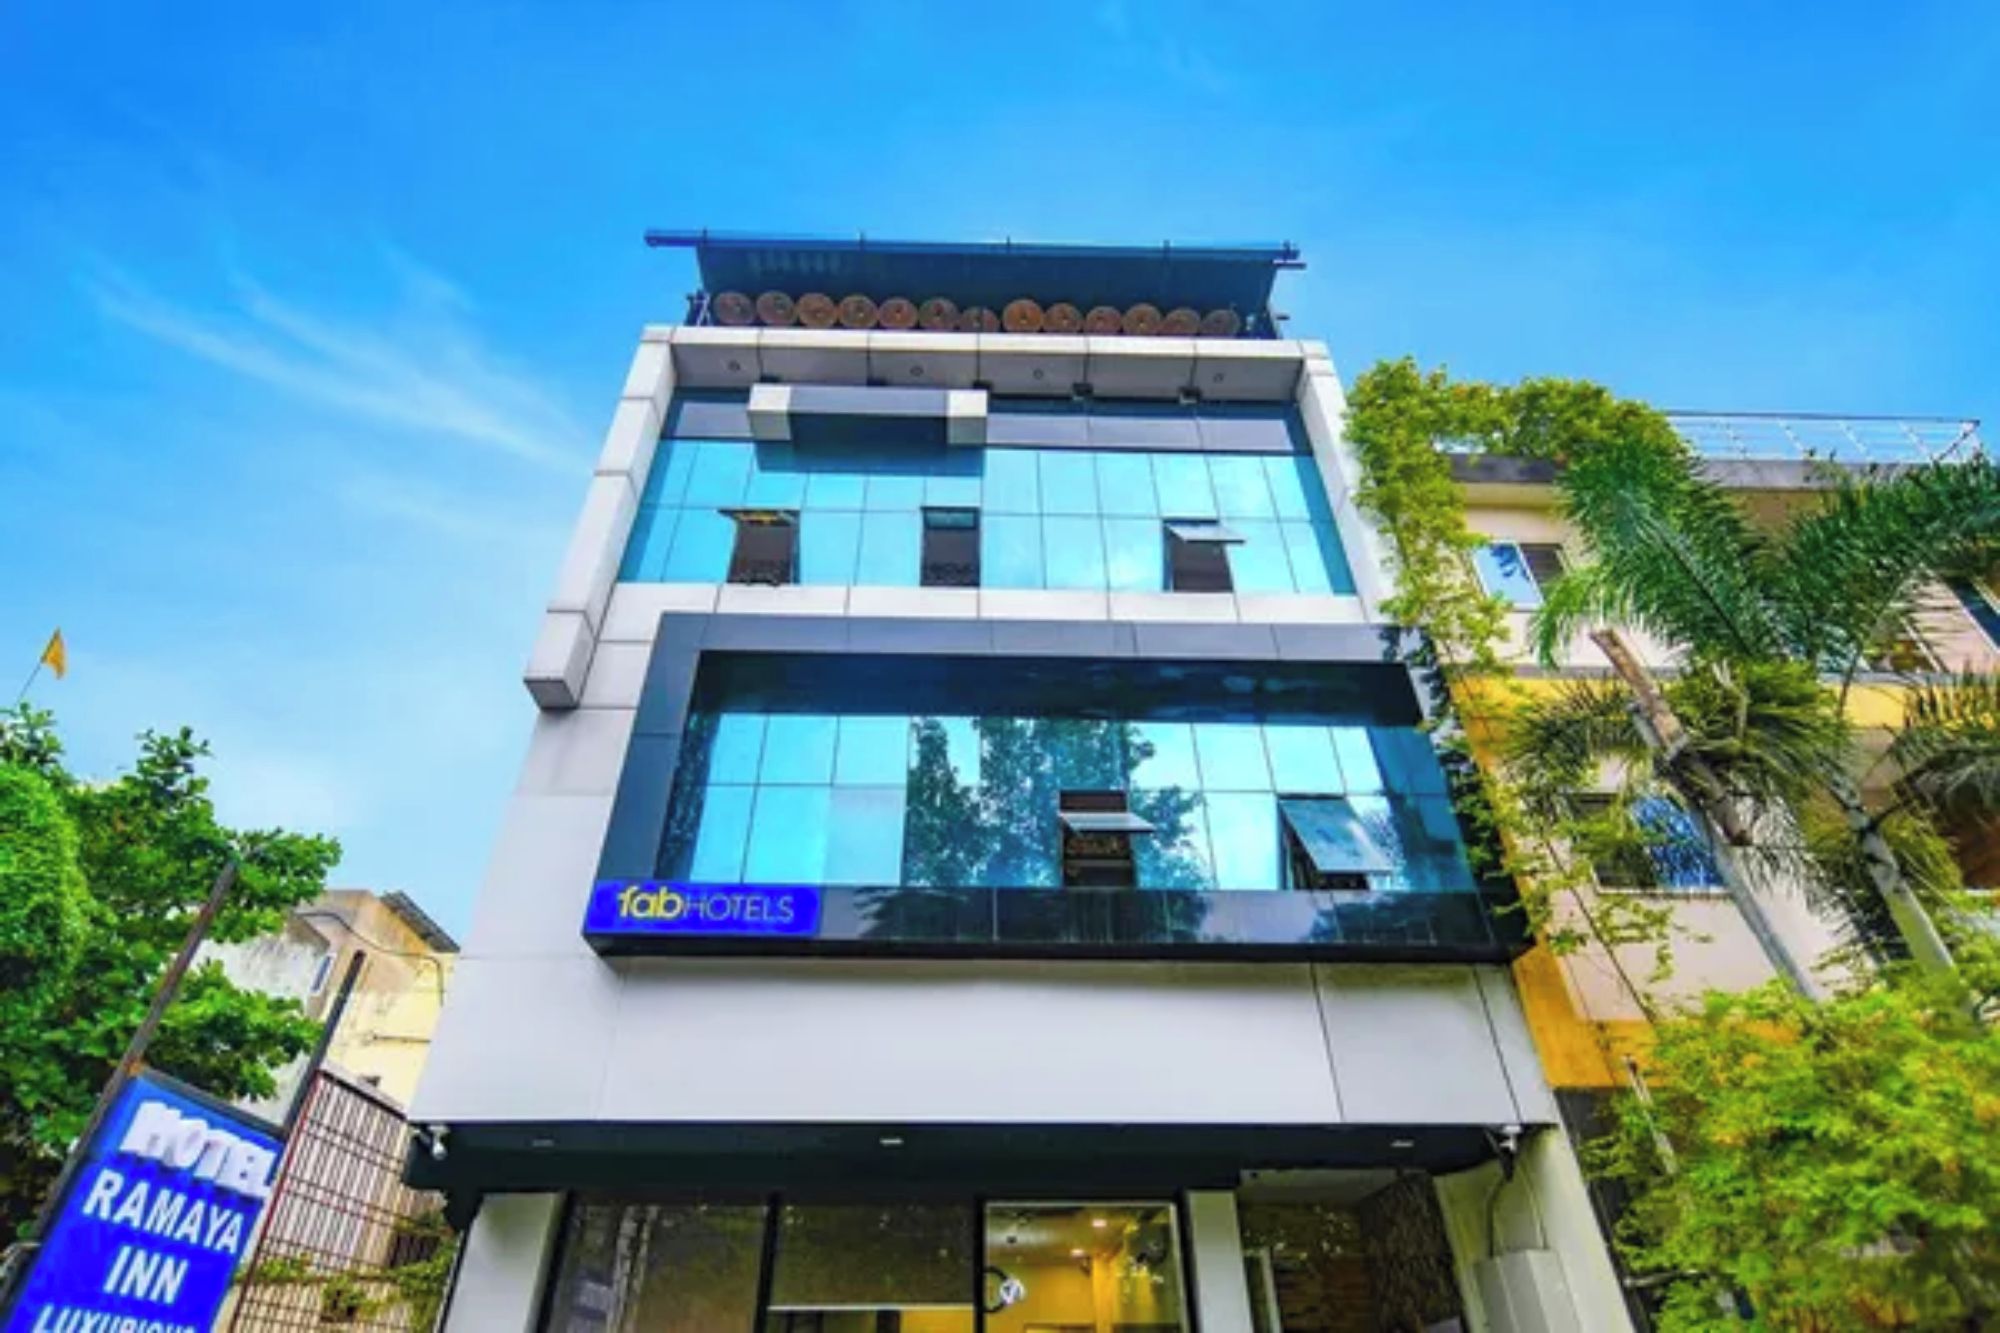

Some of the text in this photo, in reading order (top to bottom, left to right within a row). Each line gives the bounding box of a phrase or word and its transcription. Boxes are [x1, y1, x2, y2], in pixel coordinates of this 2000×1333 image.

[82, 1168, 245, 1254] RAMAYA
[103, 1246, 188, 1304] INN
[32, 1303, 195, 1333] LUXUR
